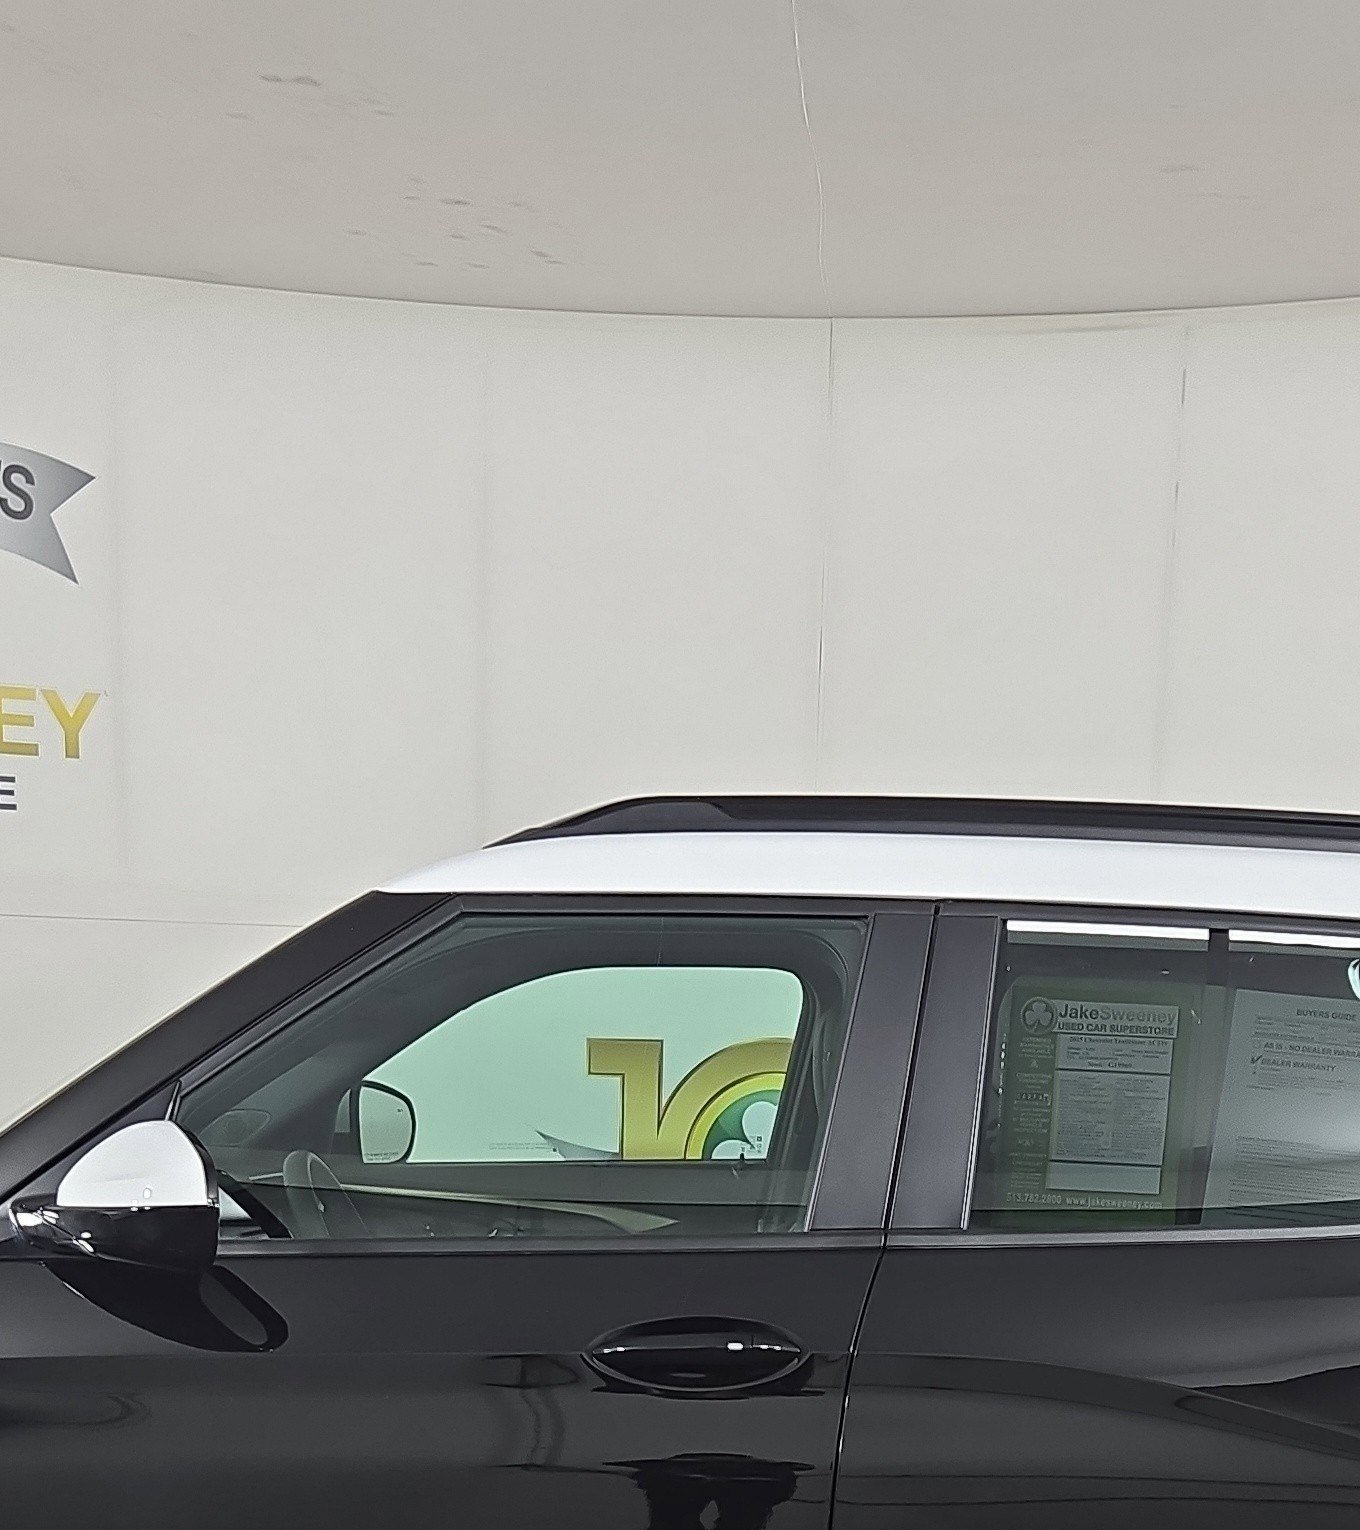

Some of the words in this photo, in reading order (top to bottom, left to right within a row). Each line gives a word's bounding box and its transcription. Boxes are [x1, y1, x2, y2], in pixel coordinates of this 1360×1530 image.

[1058, 1003, 1176, 1024] JakeSweeney
[1296, 1008, 1329, 1019] BUYERS
[1331, 1011, 1357, 1021] GUIDE
[1057, 1022, 1085, 1033] USED
[1086, 1023, 1108, 1034] CAR
[1109, 1024, 1176, 1036] SUPERSTORE
[1264, 1042, 1274, 1050] AS
[1289, 1044, 1300, 1052] NO
[1301, 1045, 1332, 1055] DEALER
[1261, 1058, 1291, 1067] DEALER
[1292, 1061, 1337, 1072] WARRANTY
